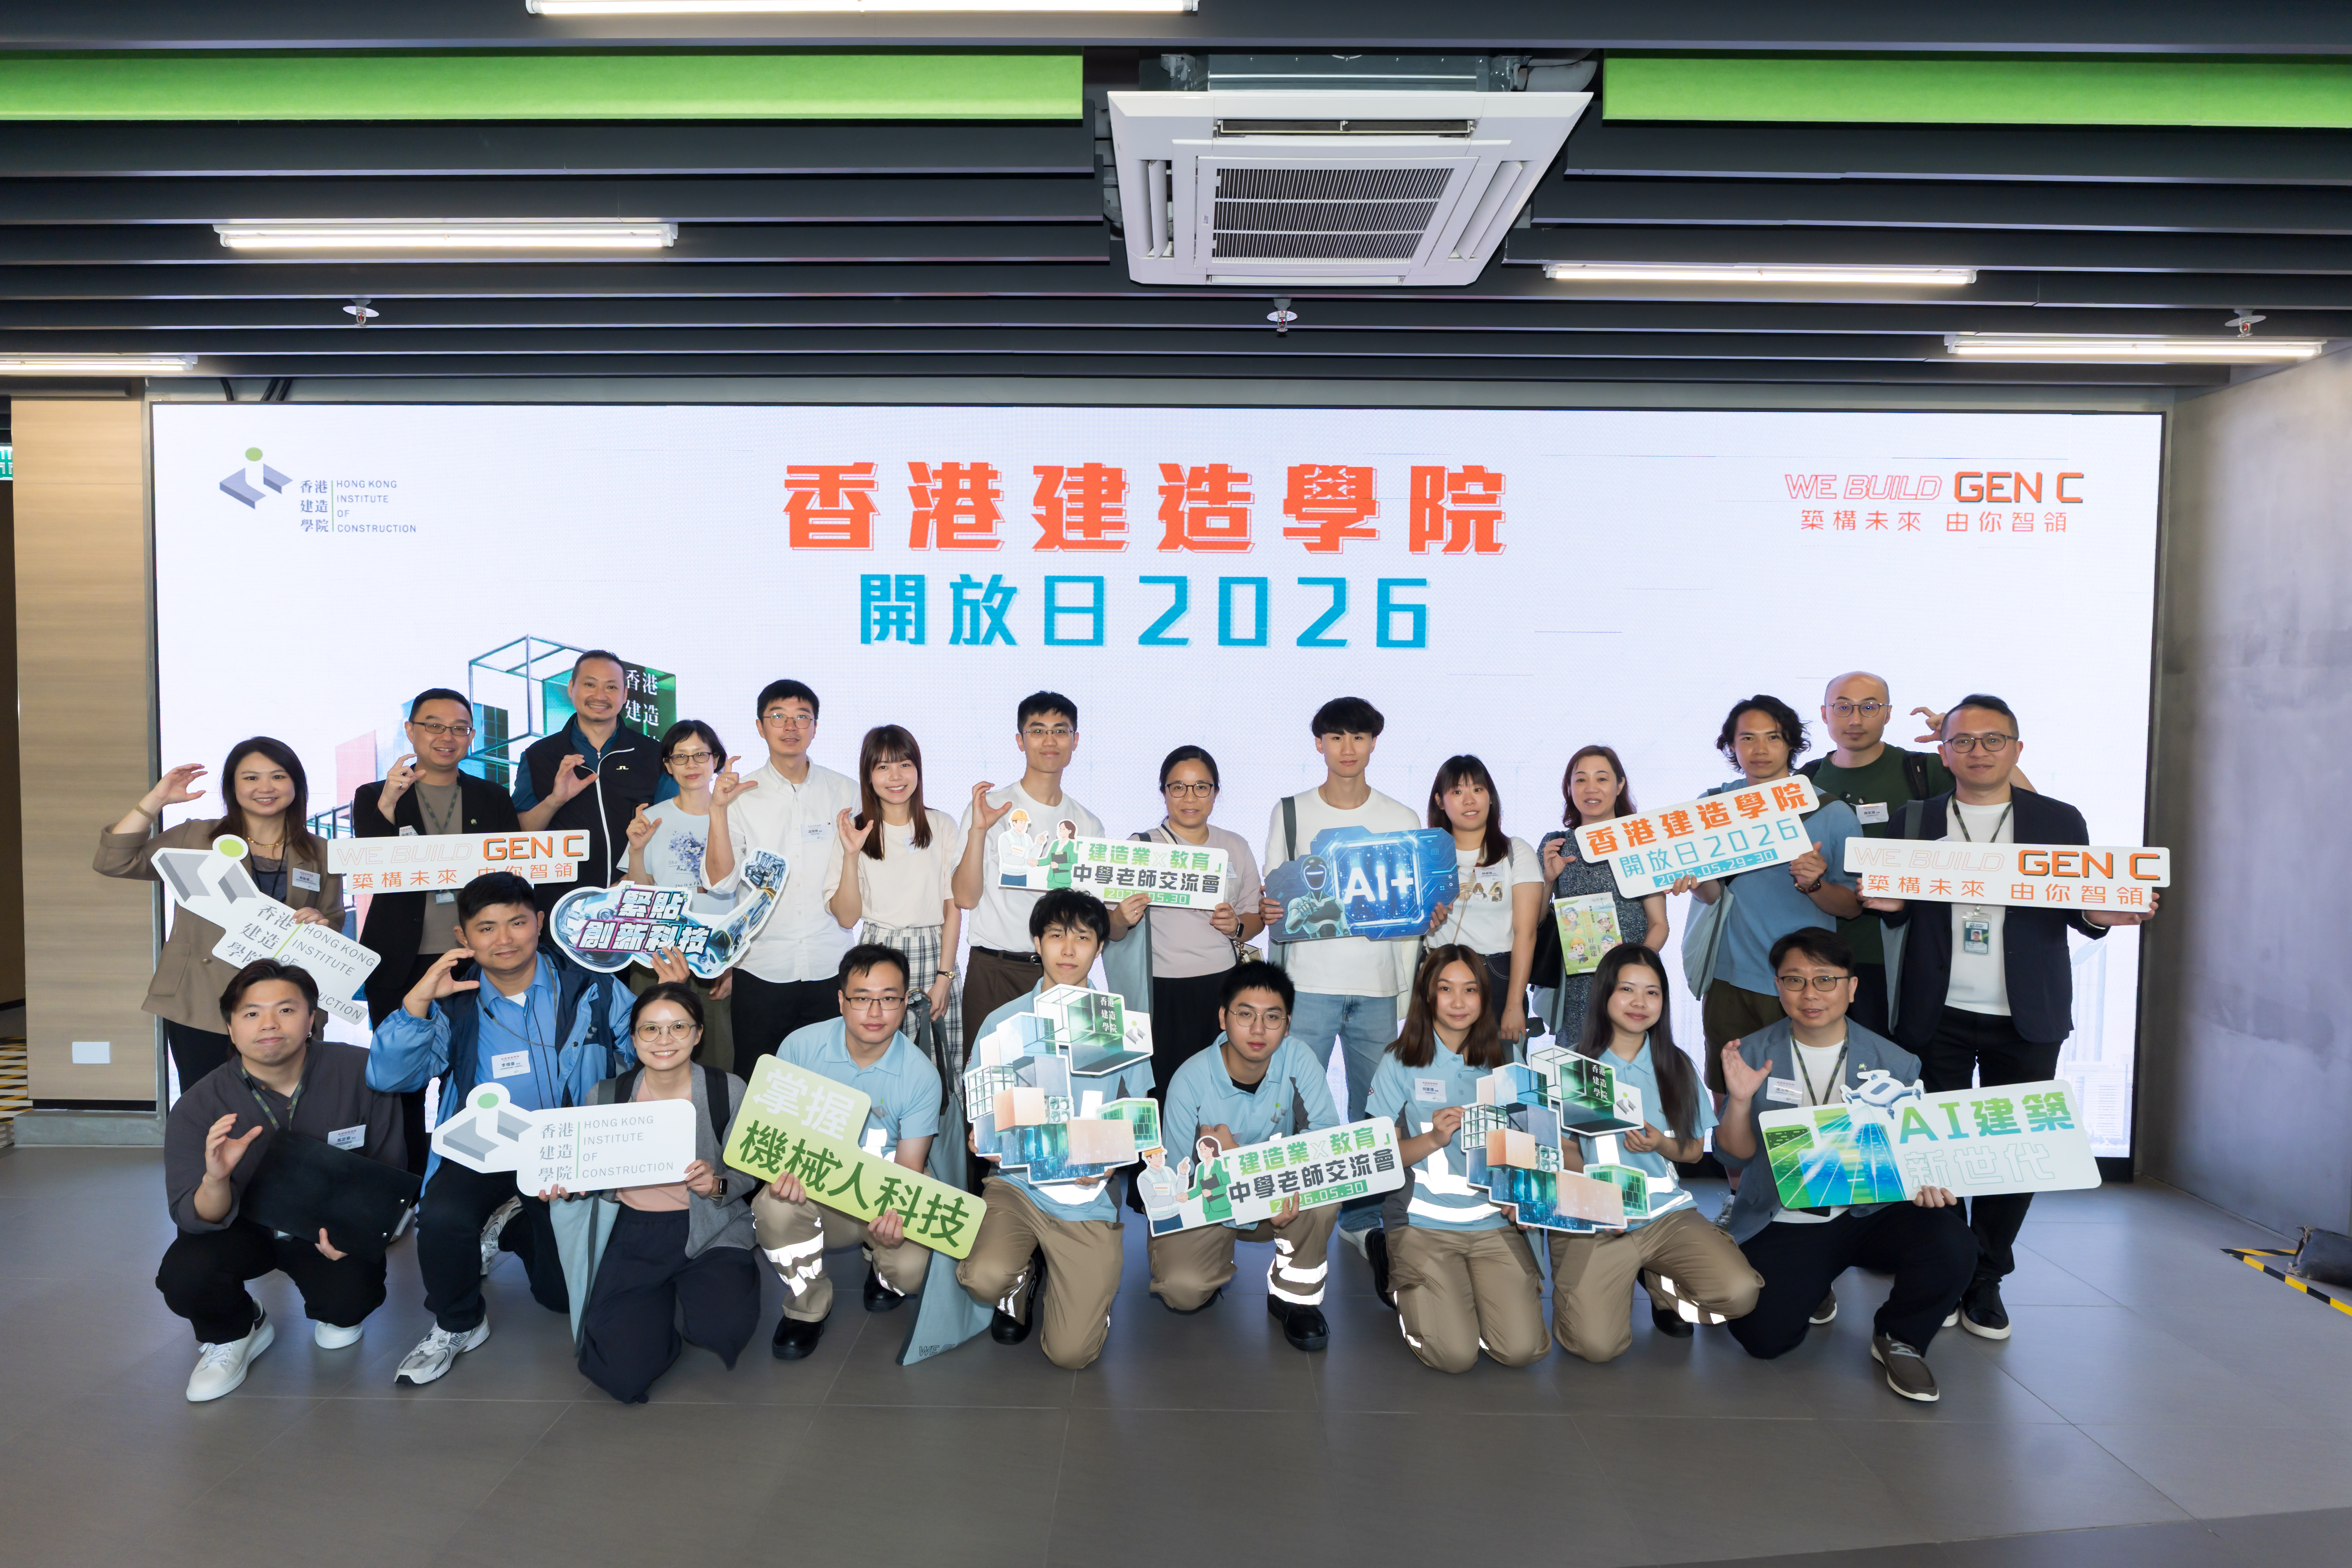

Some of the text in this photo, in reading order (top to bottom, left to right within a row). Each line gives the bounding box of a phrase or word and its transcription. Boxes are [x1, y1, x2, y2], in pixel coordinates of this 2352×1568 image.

[300, 480, 328, 493] 香港
[1785, 472, 2084, 503] WE BUILD GEN C
[300, 499, 328, 512] 建造
[783, 462, 1507, 555] 香港建造學院
[300, 519, 329, 532] 學院
[1800, 510, 2067, 533] 築構未來 由你智領
[860, 573, 1431, 649] 開放日2026
[626, 669, 657, 695] 香港
[625, 700, 659, 727] 建造
[1586, 782, 1809, 856] 香港建造學院
[337, 835, 584, 866] WE BUILD GEN C
[1619, 818, 1799, 878] 開放日2026
[1854, 847, 2161, 881] WE BUILD GEN C
[352, 868, 458, 889] 築構未來
[1073, 864, 1220, 893] 中學老師交流會
[1867, 874, 2143, 906] 築構未來 由你智領
[257, 904, 295, 930] 香港
[618, 889, 684, 920] 緊貼
[238, 922, 280, 949] 建造
[304, 925, 375, 967] HONG KONG
[578, 920, 711, 954] 創新科技
[292, 939, 355, 976] INSTITUTE
[318, 992, 363, 1019] UCTION
[752, 1068, 855, 1141] 掌握
[1899, 1091, 2076, 1144] AI建築
[541, 1122, 574, 1139] 香港
[584, 1116, 653, 1129] HONG KONG
[539, 1144, 572, 1161] 建造
[584, 1132, 643, 1145] INSTITUTE
[582, 1162, 673, 1178] CONSTRUCTION
[583, 1152, 597, 1162] OF
[1904, 1142, 2056, 1189] 新世代
[538, 1166, 572, 1182] 學院
[739, 1119, 970, 1248] 機械人科技
[1229, 1148, 1395, 1203] 中學老師交流會
[919, 1345, 940, 1356] WE
